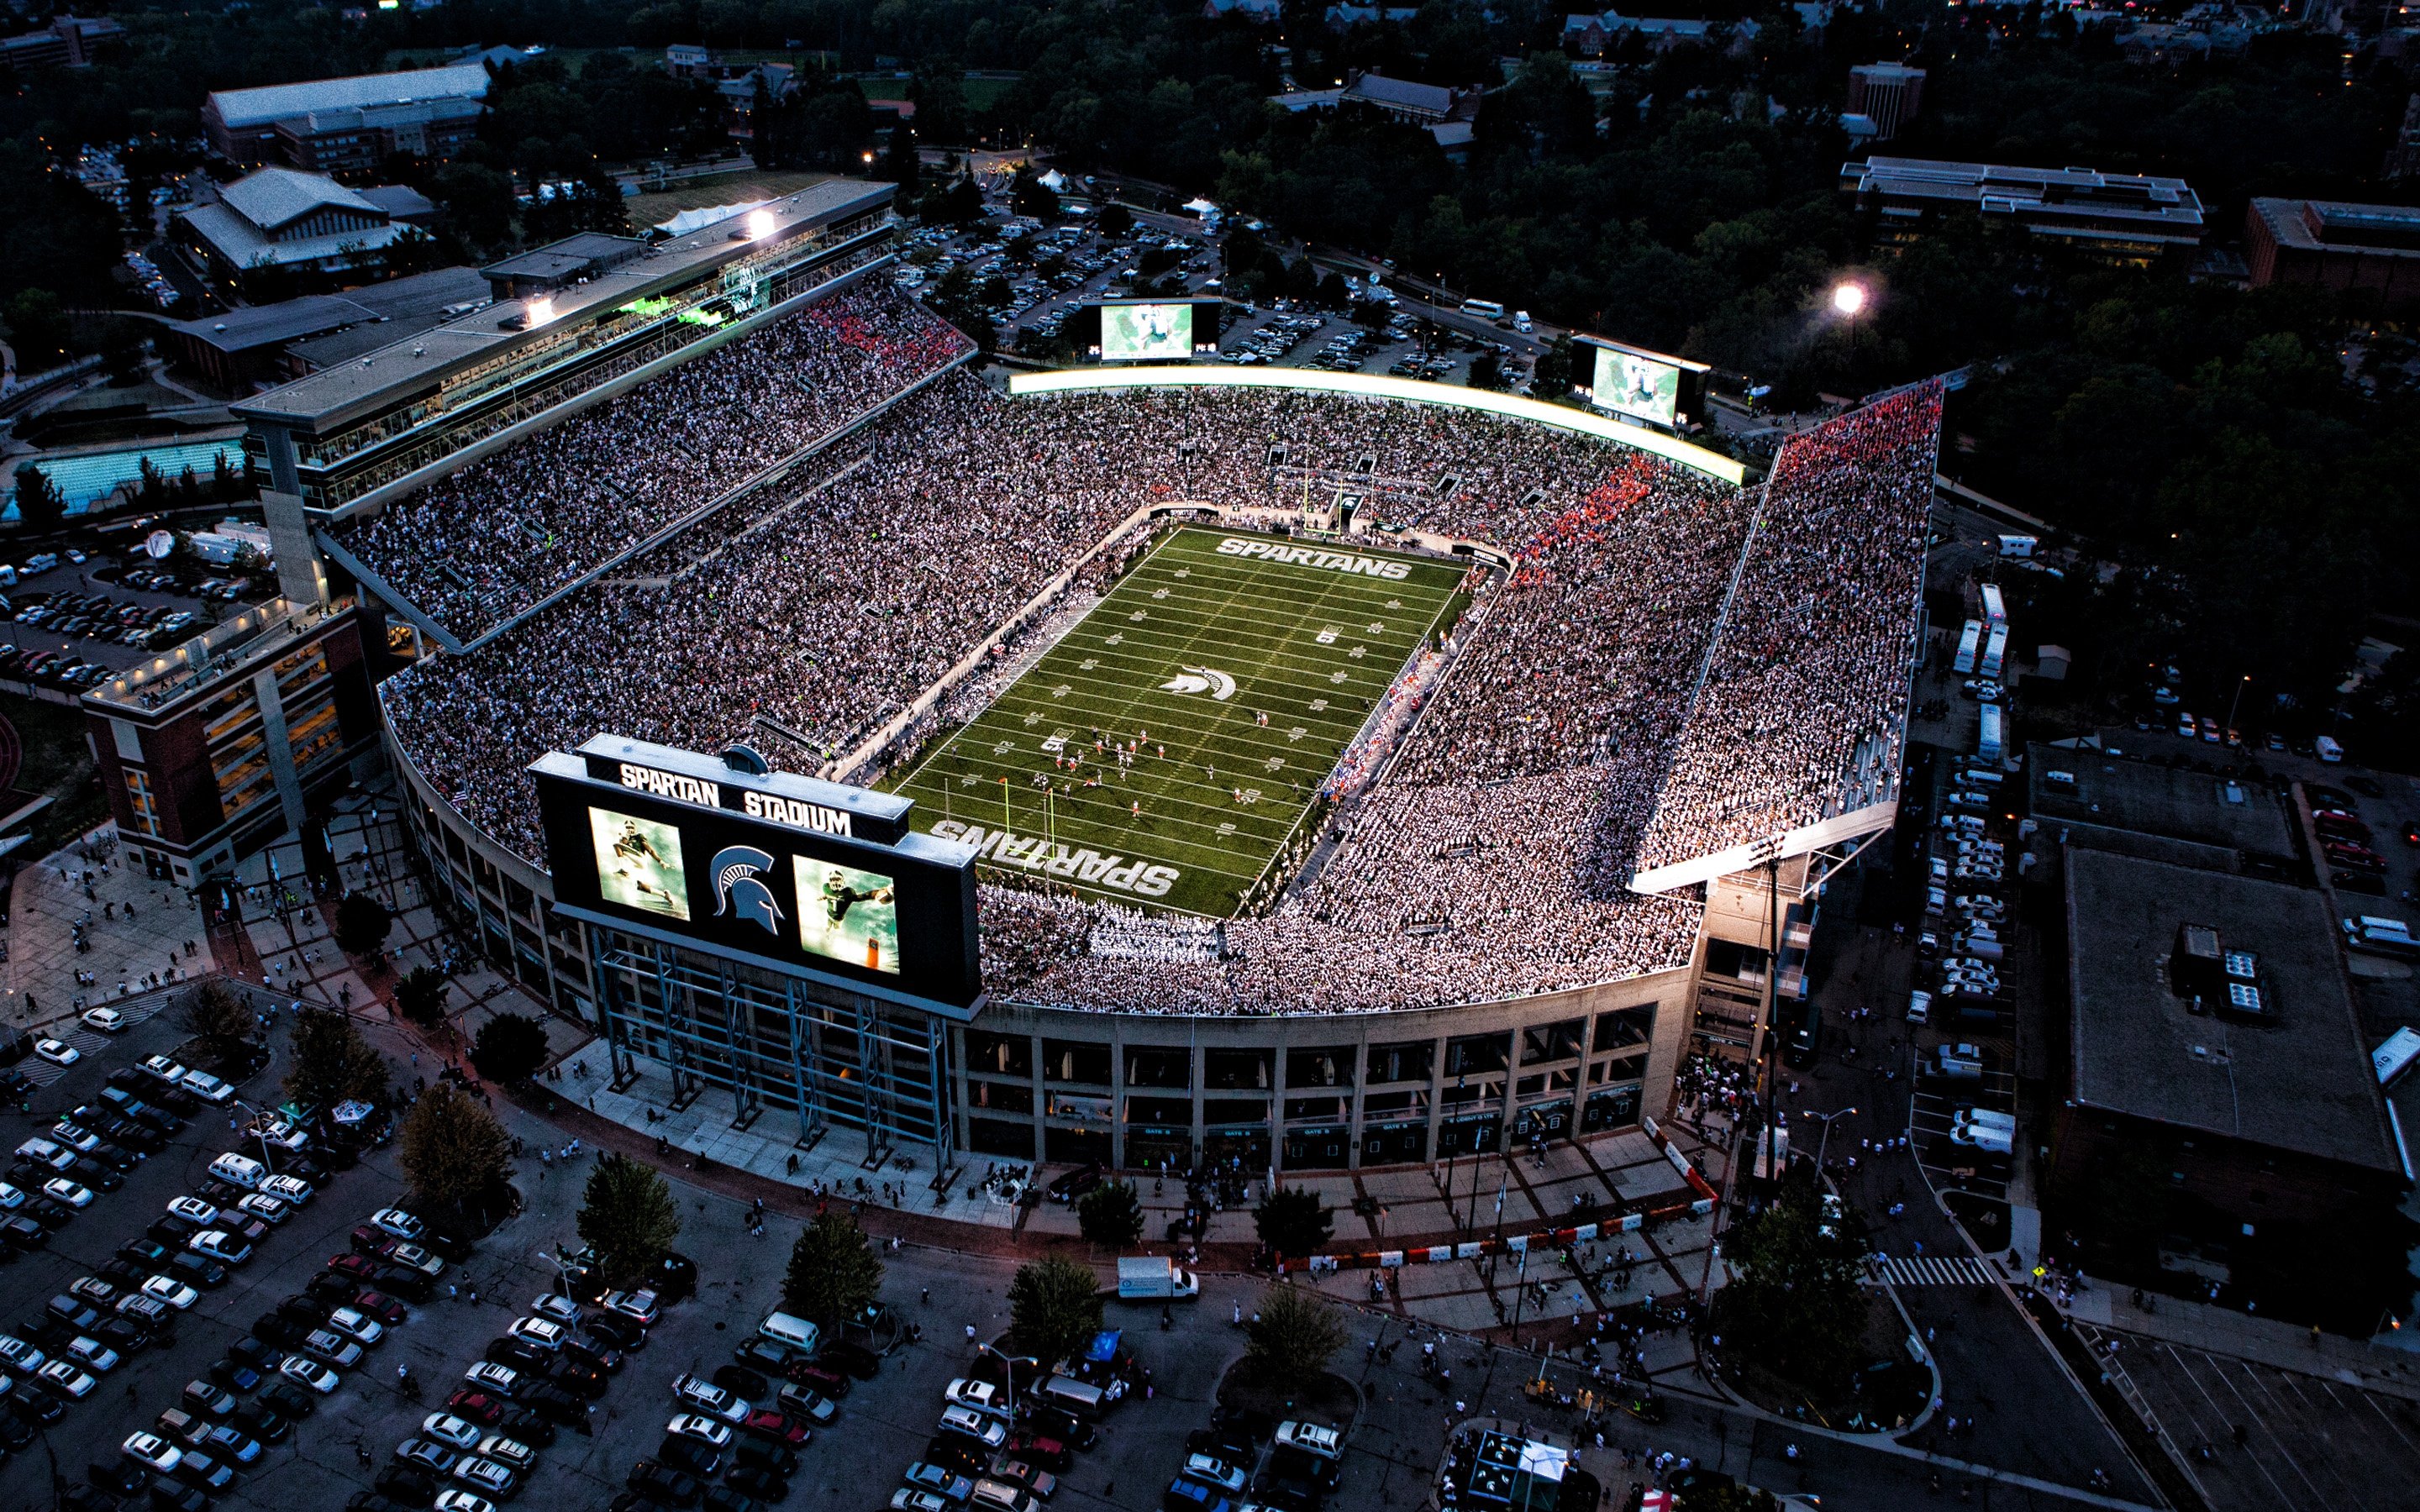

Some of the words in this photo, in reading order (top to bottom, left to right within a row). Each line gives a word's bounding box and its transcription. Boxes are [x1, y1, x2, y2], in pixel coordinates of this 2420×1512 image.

[1215, 538, 1412, 579] SPARTANS
[619, 763, 720, 808] SPARTAN
[744, 791, 852, 837] STADIUM
[929, 820, 1181, 896] SPARTANS
